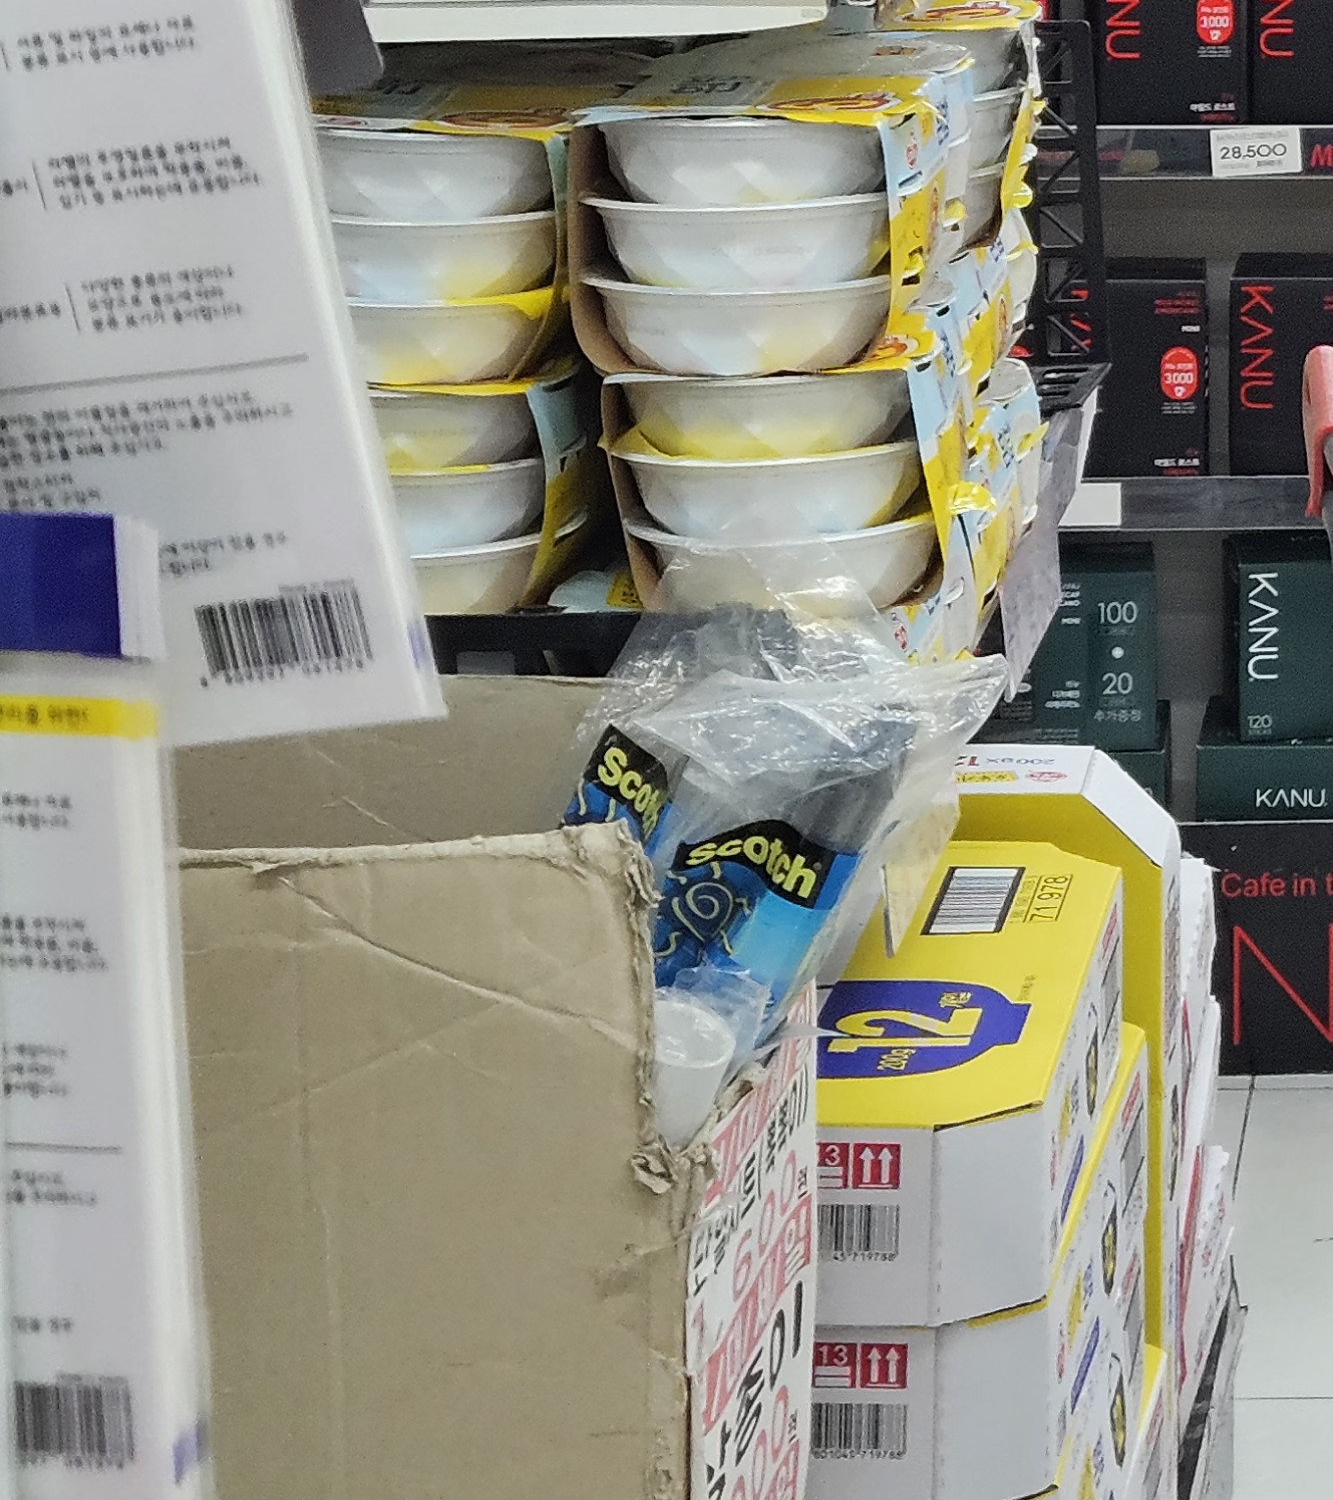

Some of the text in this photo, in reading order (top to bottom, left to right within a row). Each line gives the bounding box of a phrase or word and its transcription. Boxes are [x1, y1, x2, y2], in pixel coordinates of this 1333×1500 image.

[1219, 143, 1288, 160] 28,500
[1240, 285, 1274, 410] KANU
[1097, 601, 1138, 624] 100
[1248, 572, 1280, 680] KANU
[1102, 672, 1134, 695] 20
[1248, 714, 1273, 728] 120
[1255, 788, 1326, 808] KANU
[687, 834, 818, 900] Scotch
[1036, 875, 1069, 901] 978
[1220, 871, 1286, 899] Cafe
[1293, 871, 1316, 895] in
[827, 1007, 984, 1054] 12
[818, 1344, 848, 1366] 13
